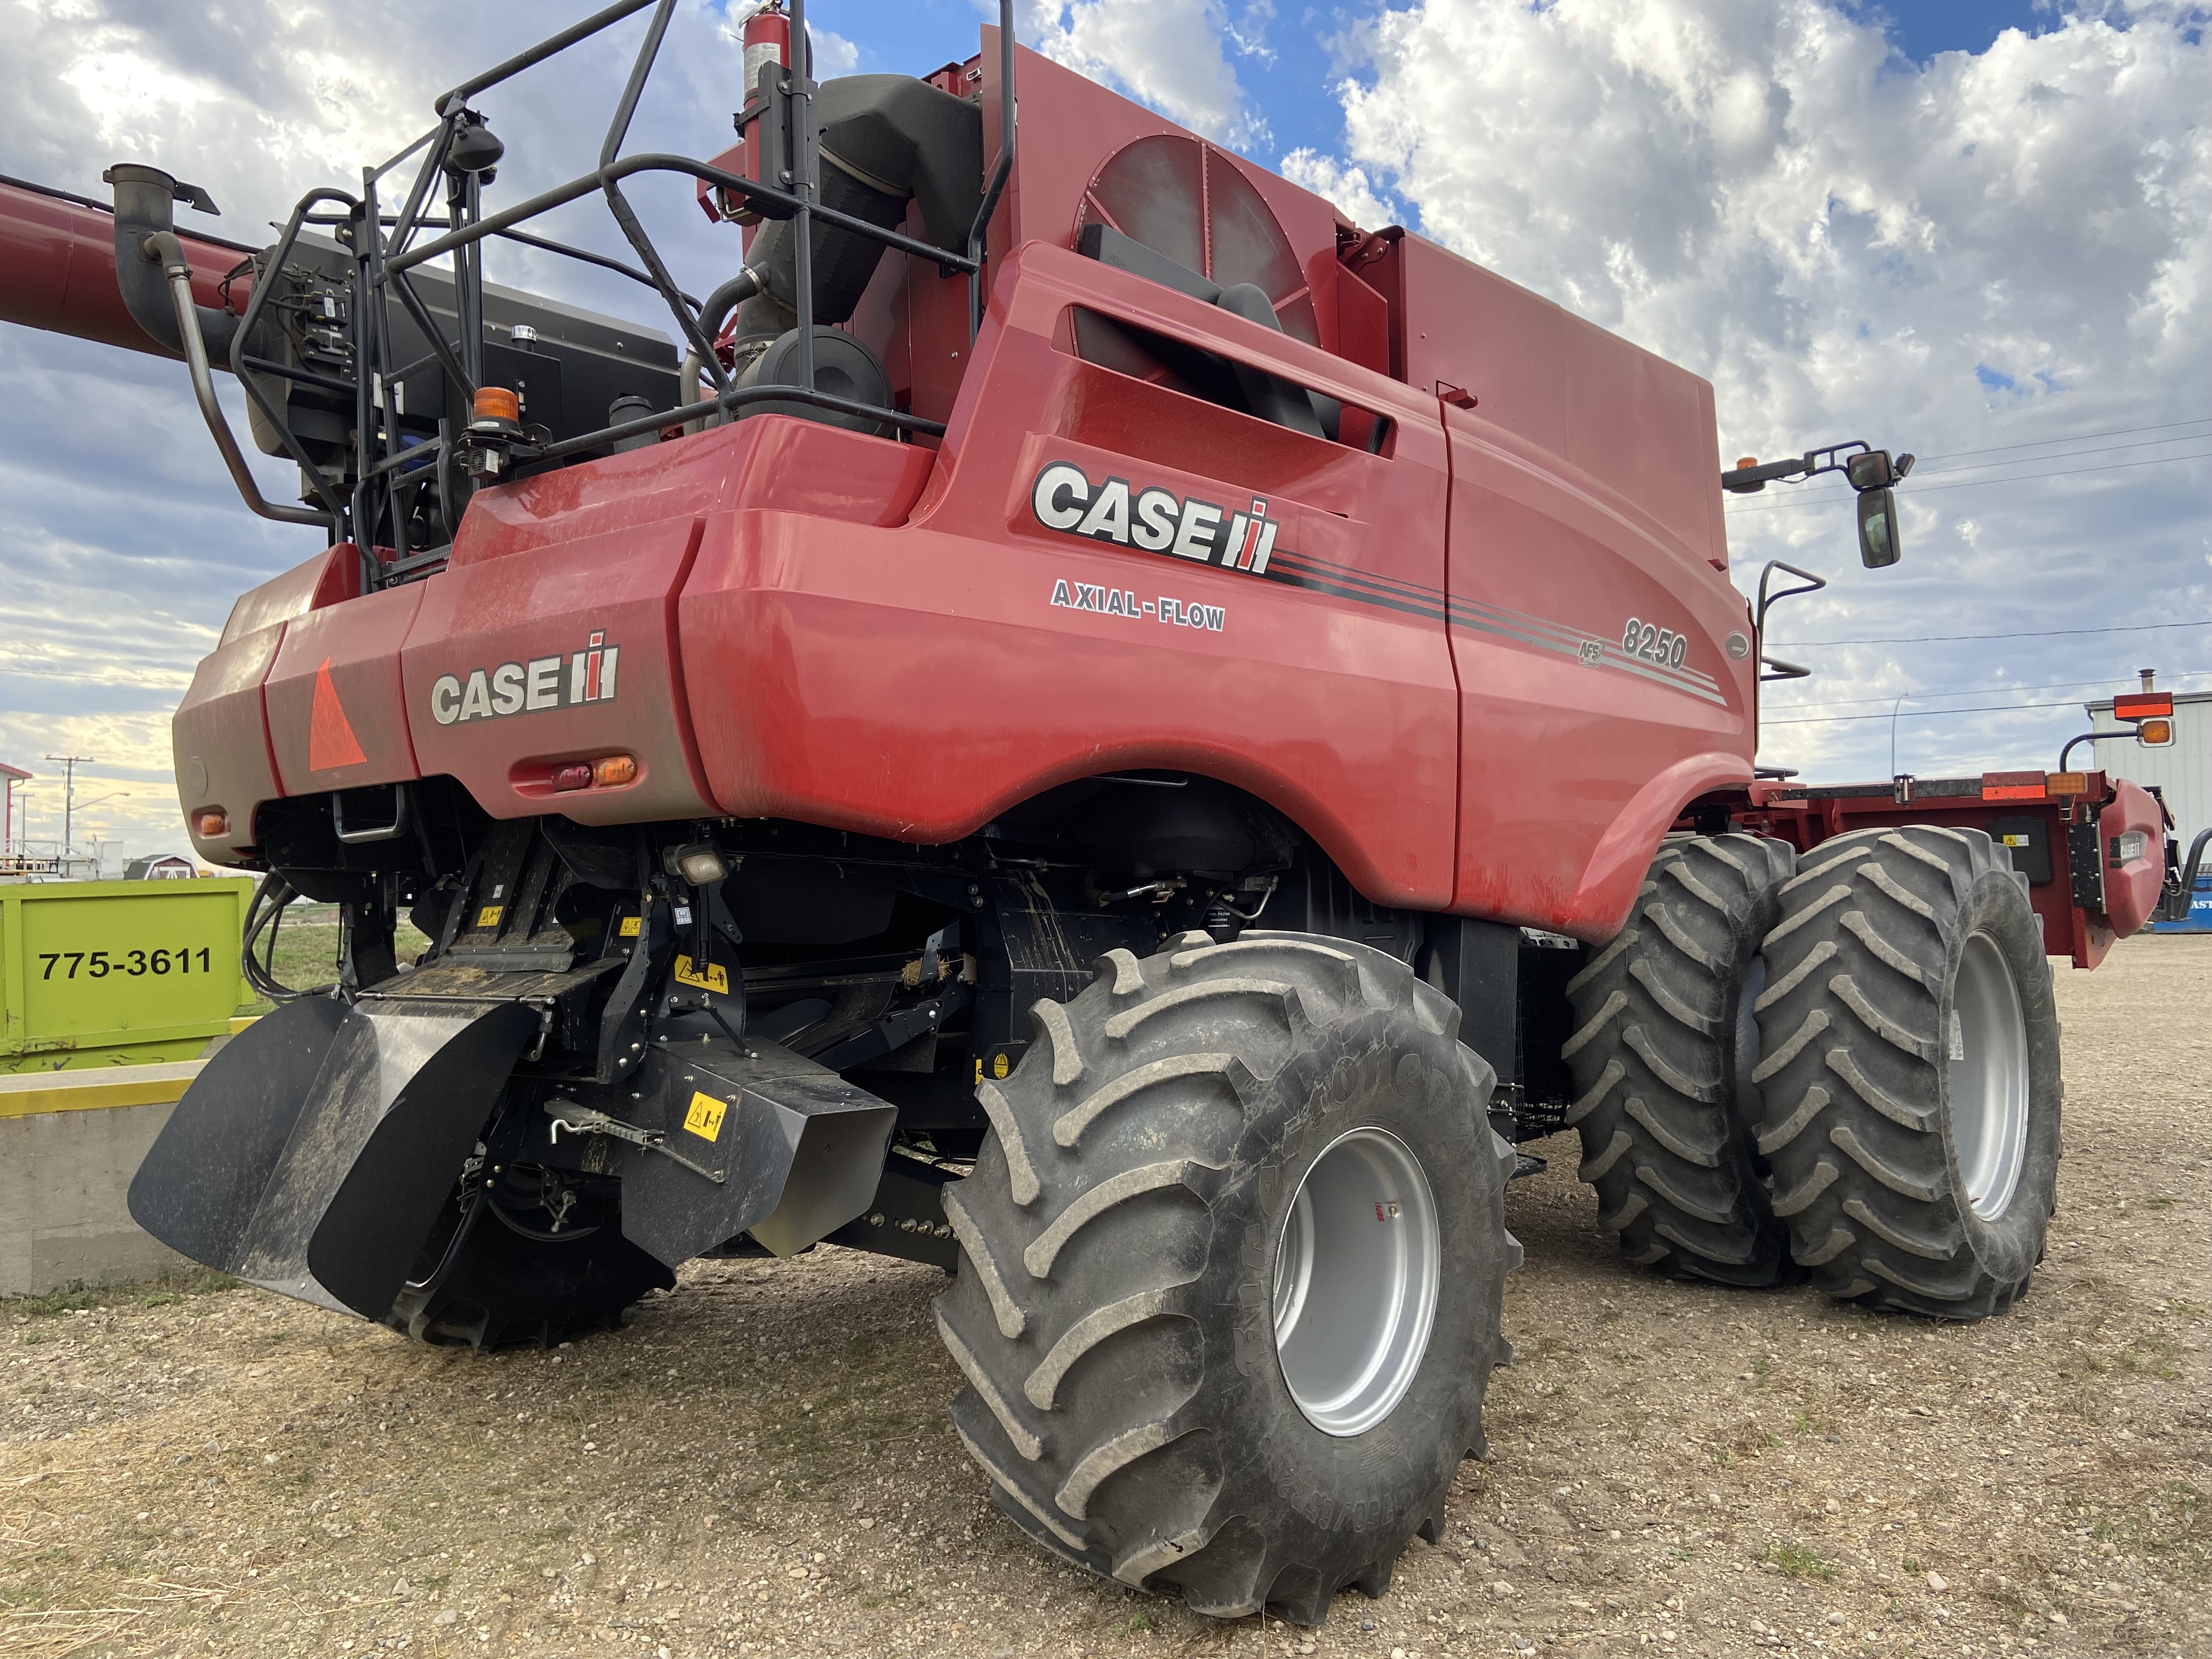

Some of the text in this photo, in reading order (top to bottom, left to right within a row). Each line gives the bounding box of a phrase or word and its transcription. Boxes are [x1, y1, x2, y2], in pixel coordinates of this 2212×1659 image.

[1034, 465, 1223, 562] CASE
[1050, 578, 1226, 632] AXIAL-FLOW
[1578, 641, 1600, 660] AFS
[1622, 617, 1687, 672] 8250
[431, 656, 562, 725] CASE
[38, 947, 210, 980] 775-3611
